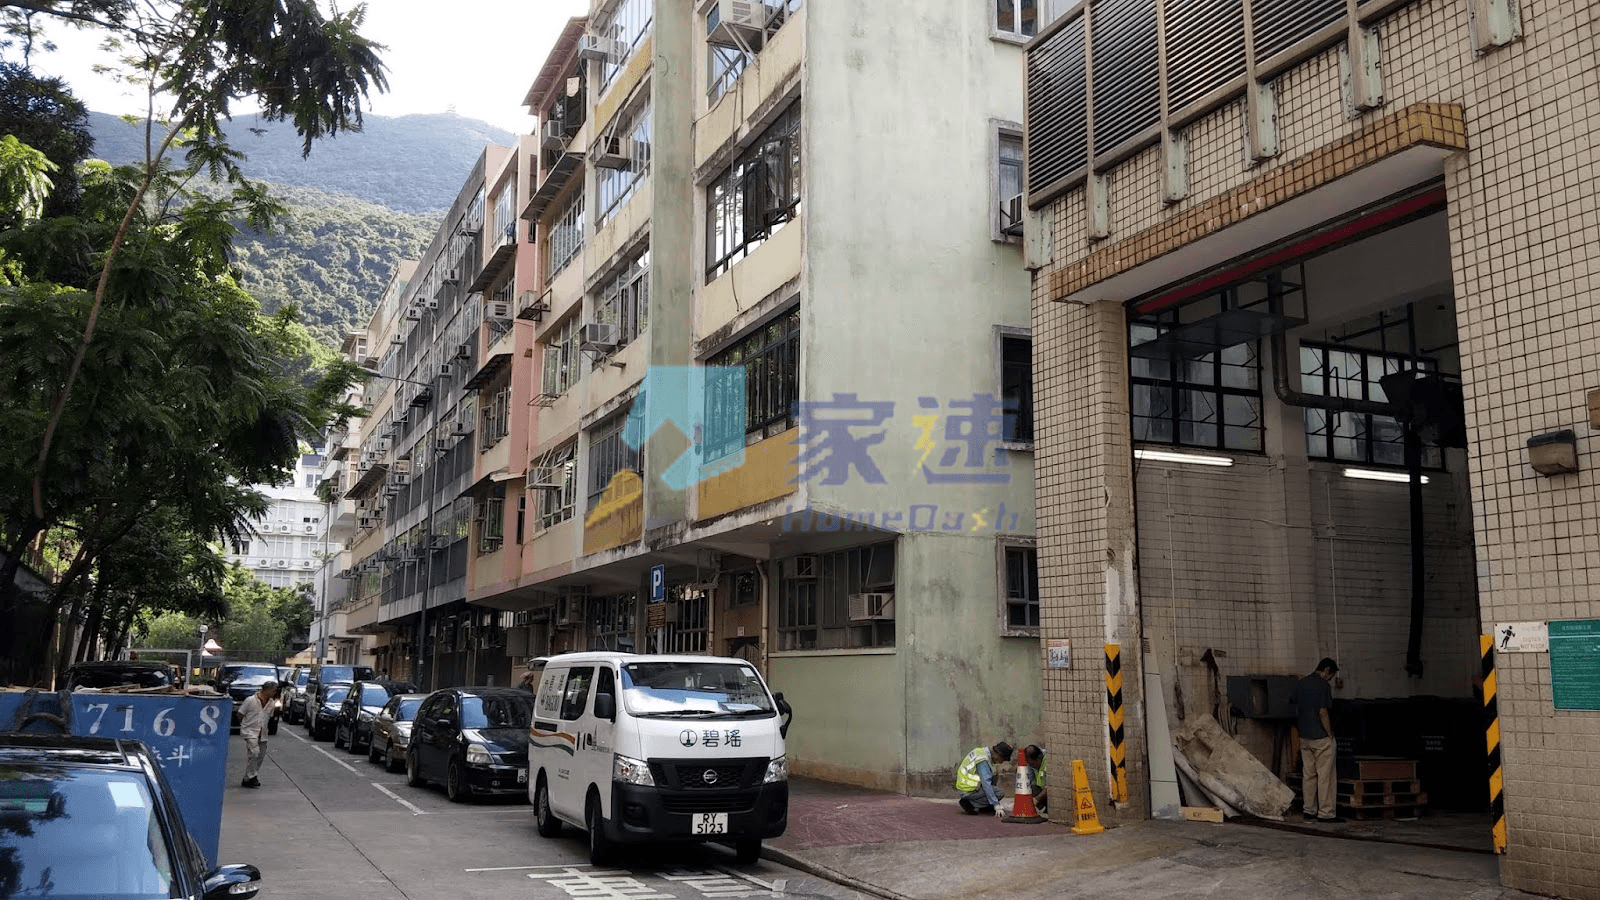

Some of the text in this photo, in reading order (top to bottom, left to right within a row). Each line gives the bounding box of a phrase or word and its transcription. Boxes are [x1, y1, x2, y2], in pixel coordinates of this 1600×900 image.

[653, 569, 662, 598] P
[87, 703, 220, 737] 7168
[702, 729, 741, 748] 碧瑤
[703, 813, 717, 824] RY
[697, 823, 724, 834] 5123
